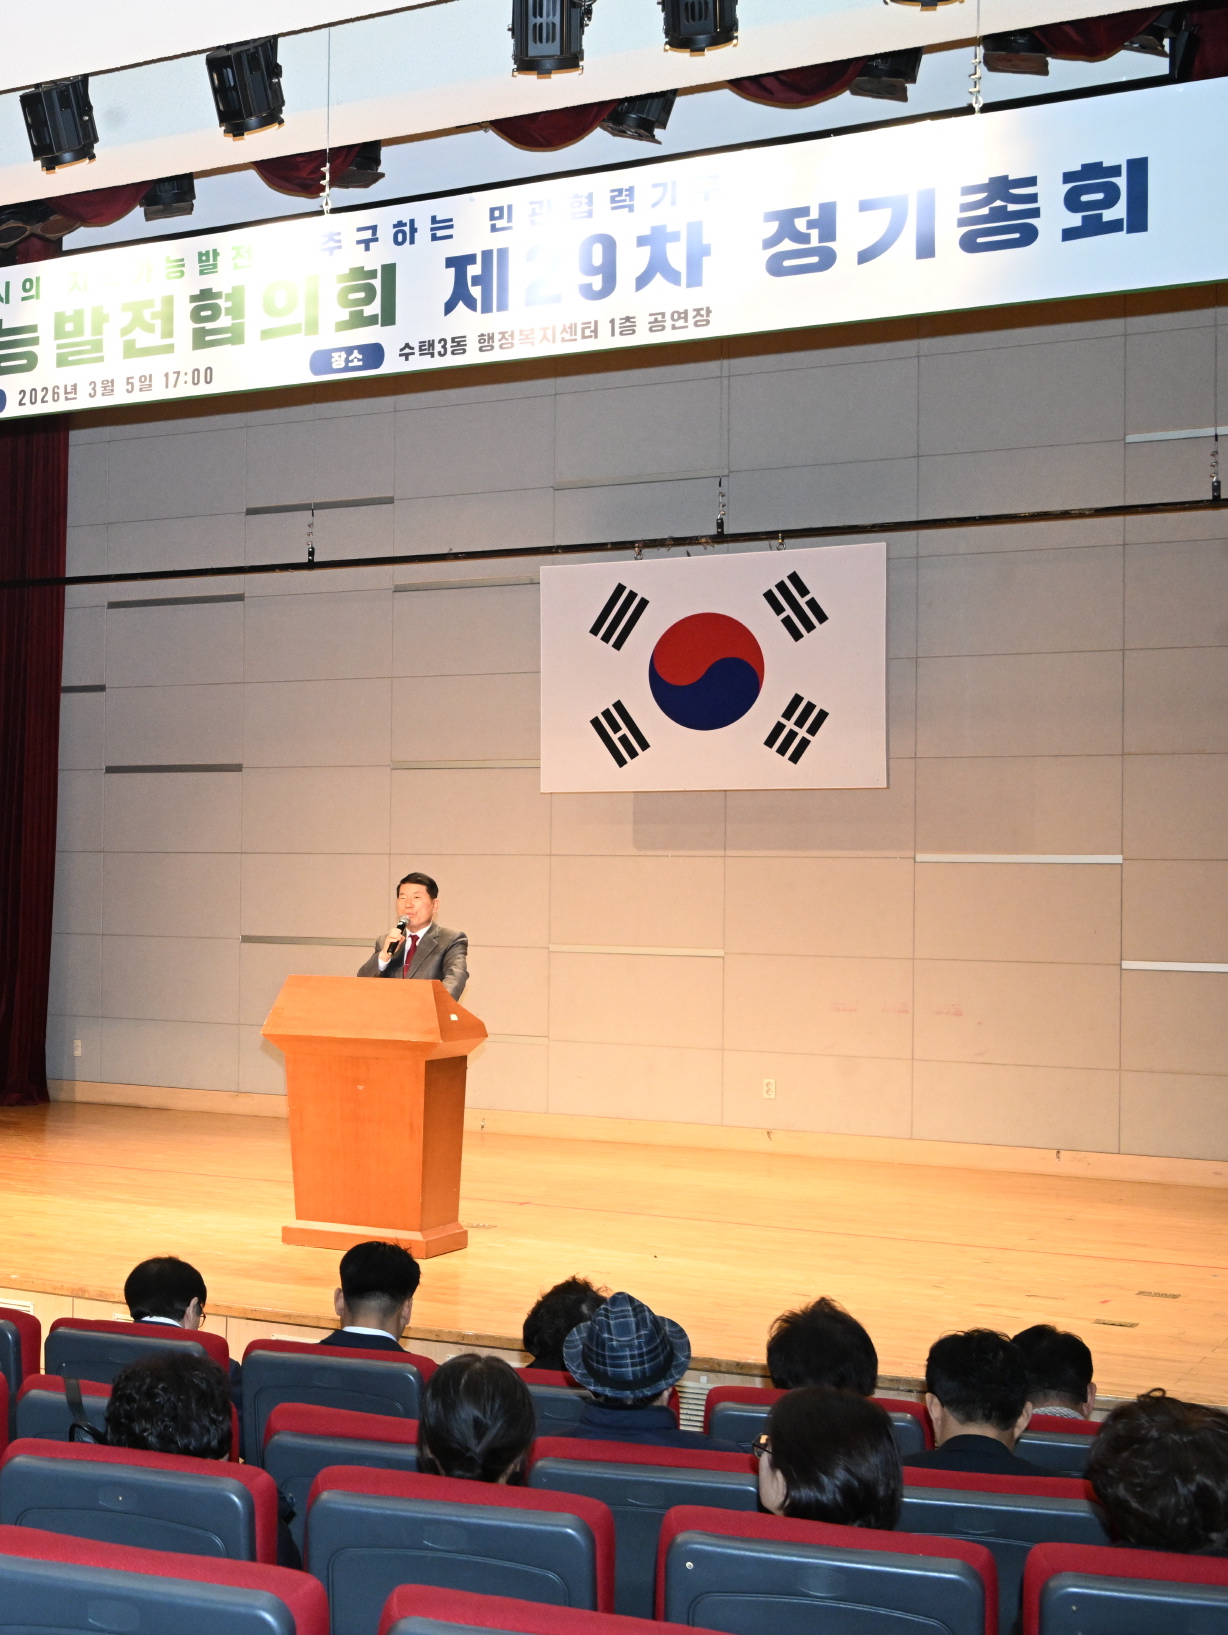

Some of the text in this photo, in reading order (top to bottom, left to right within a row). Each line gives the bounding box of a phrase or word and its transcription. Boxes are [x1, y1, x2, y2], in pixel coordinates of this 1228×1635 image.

[320, 213, 455, 257] 추구하는
[488, 174, 721, 234] 민관협력기구
[443, 218, 712, 318] 제29차
[761, 155, 1150, 278] 정기총회
[330, 305, 713, 370] 장소 수택3동 행정복지센터 1층 공연장
[18, 382, 78, 407] 2026년
[88, 378, 116, 399] 3월
[125, 373, 153, 394] 5일
[163, 366, 214, 390] 17:00
